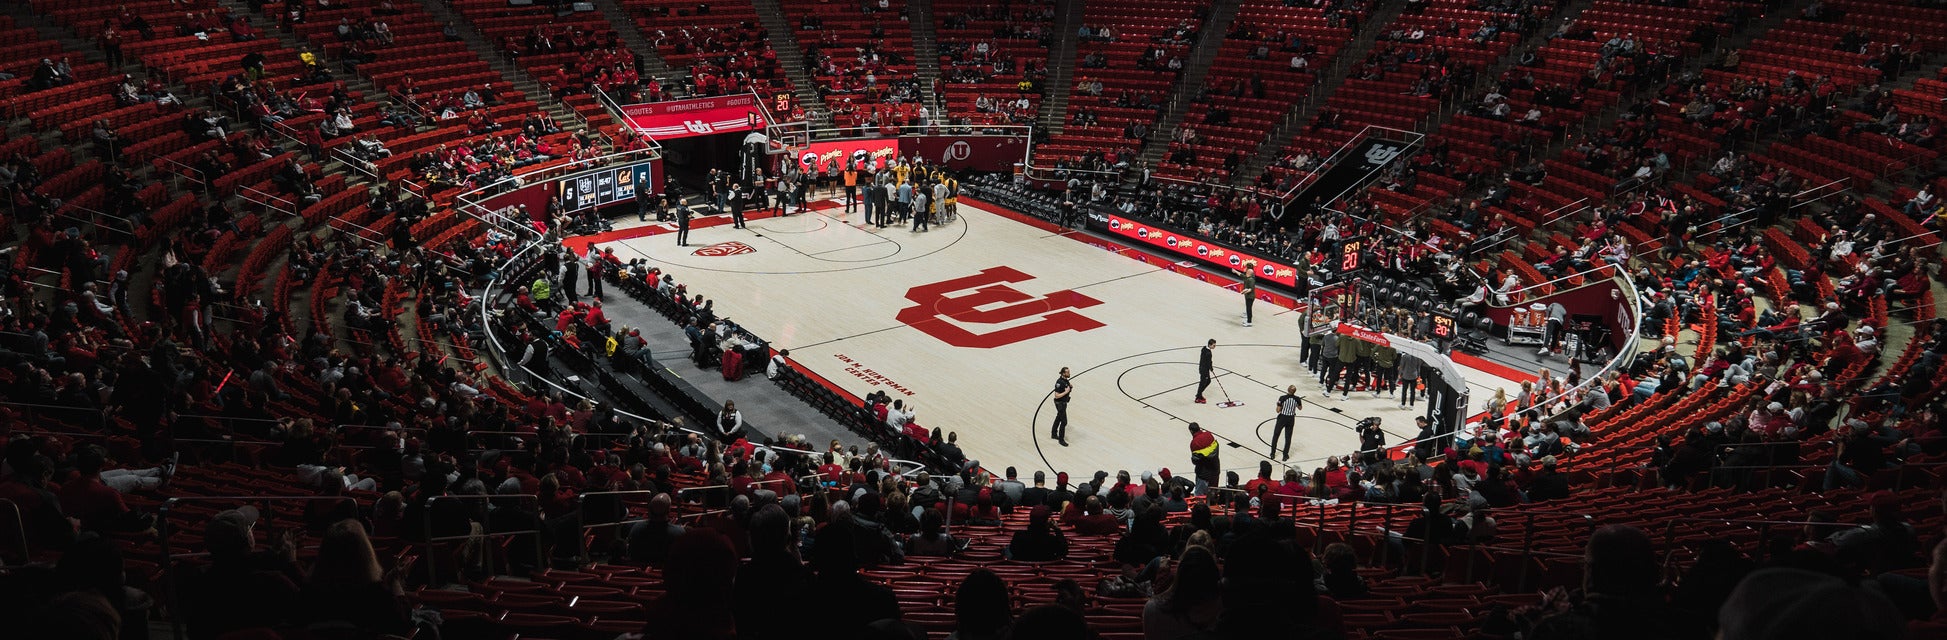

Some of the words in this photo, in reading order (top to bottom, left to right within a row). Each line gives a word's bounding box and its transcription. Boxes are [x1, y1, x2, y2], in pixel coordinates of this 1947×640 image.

[666, 101, 715, 112] @UTAHATHLETICS
[726, 98, 751, 106] #GOUTES
[777, 100, 789, 111] 20
[626, 107, 653, 116] #GOUTES
[618, 170, 633, 184] Cal
[566, 187, 573, 200] 5
[1343, 252, 1357, 270] 20
[1435, 324, 1448, 336] 20
[834, 354, 854, 363] JON
[863, 368, 915, 396] HUNTSMAN
[845, 367, 880, 386] CENTER
